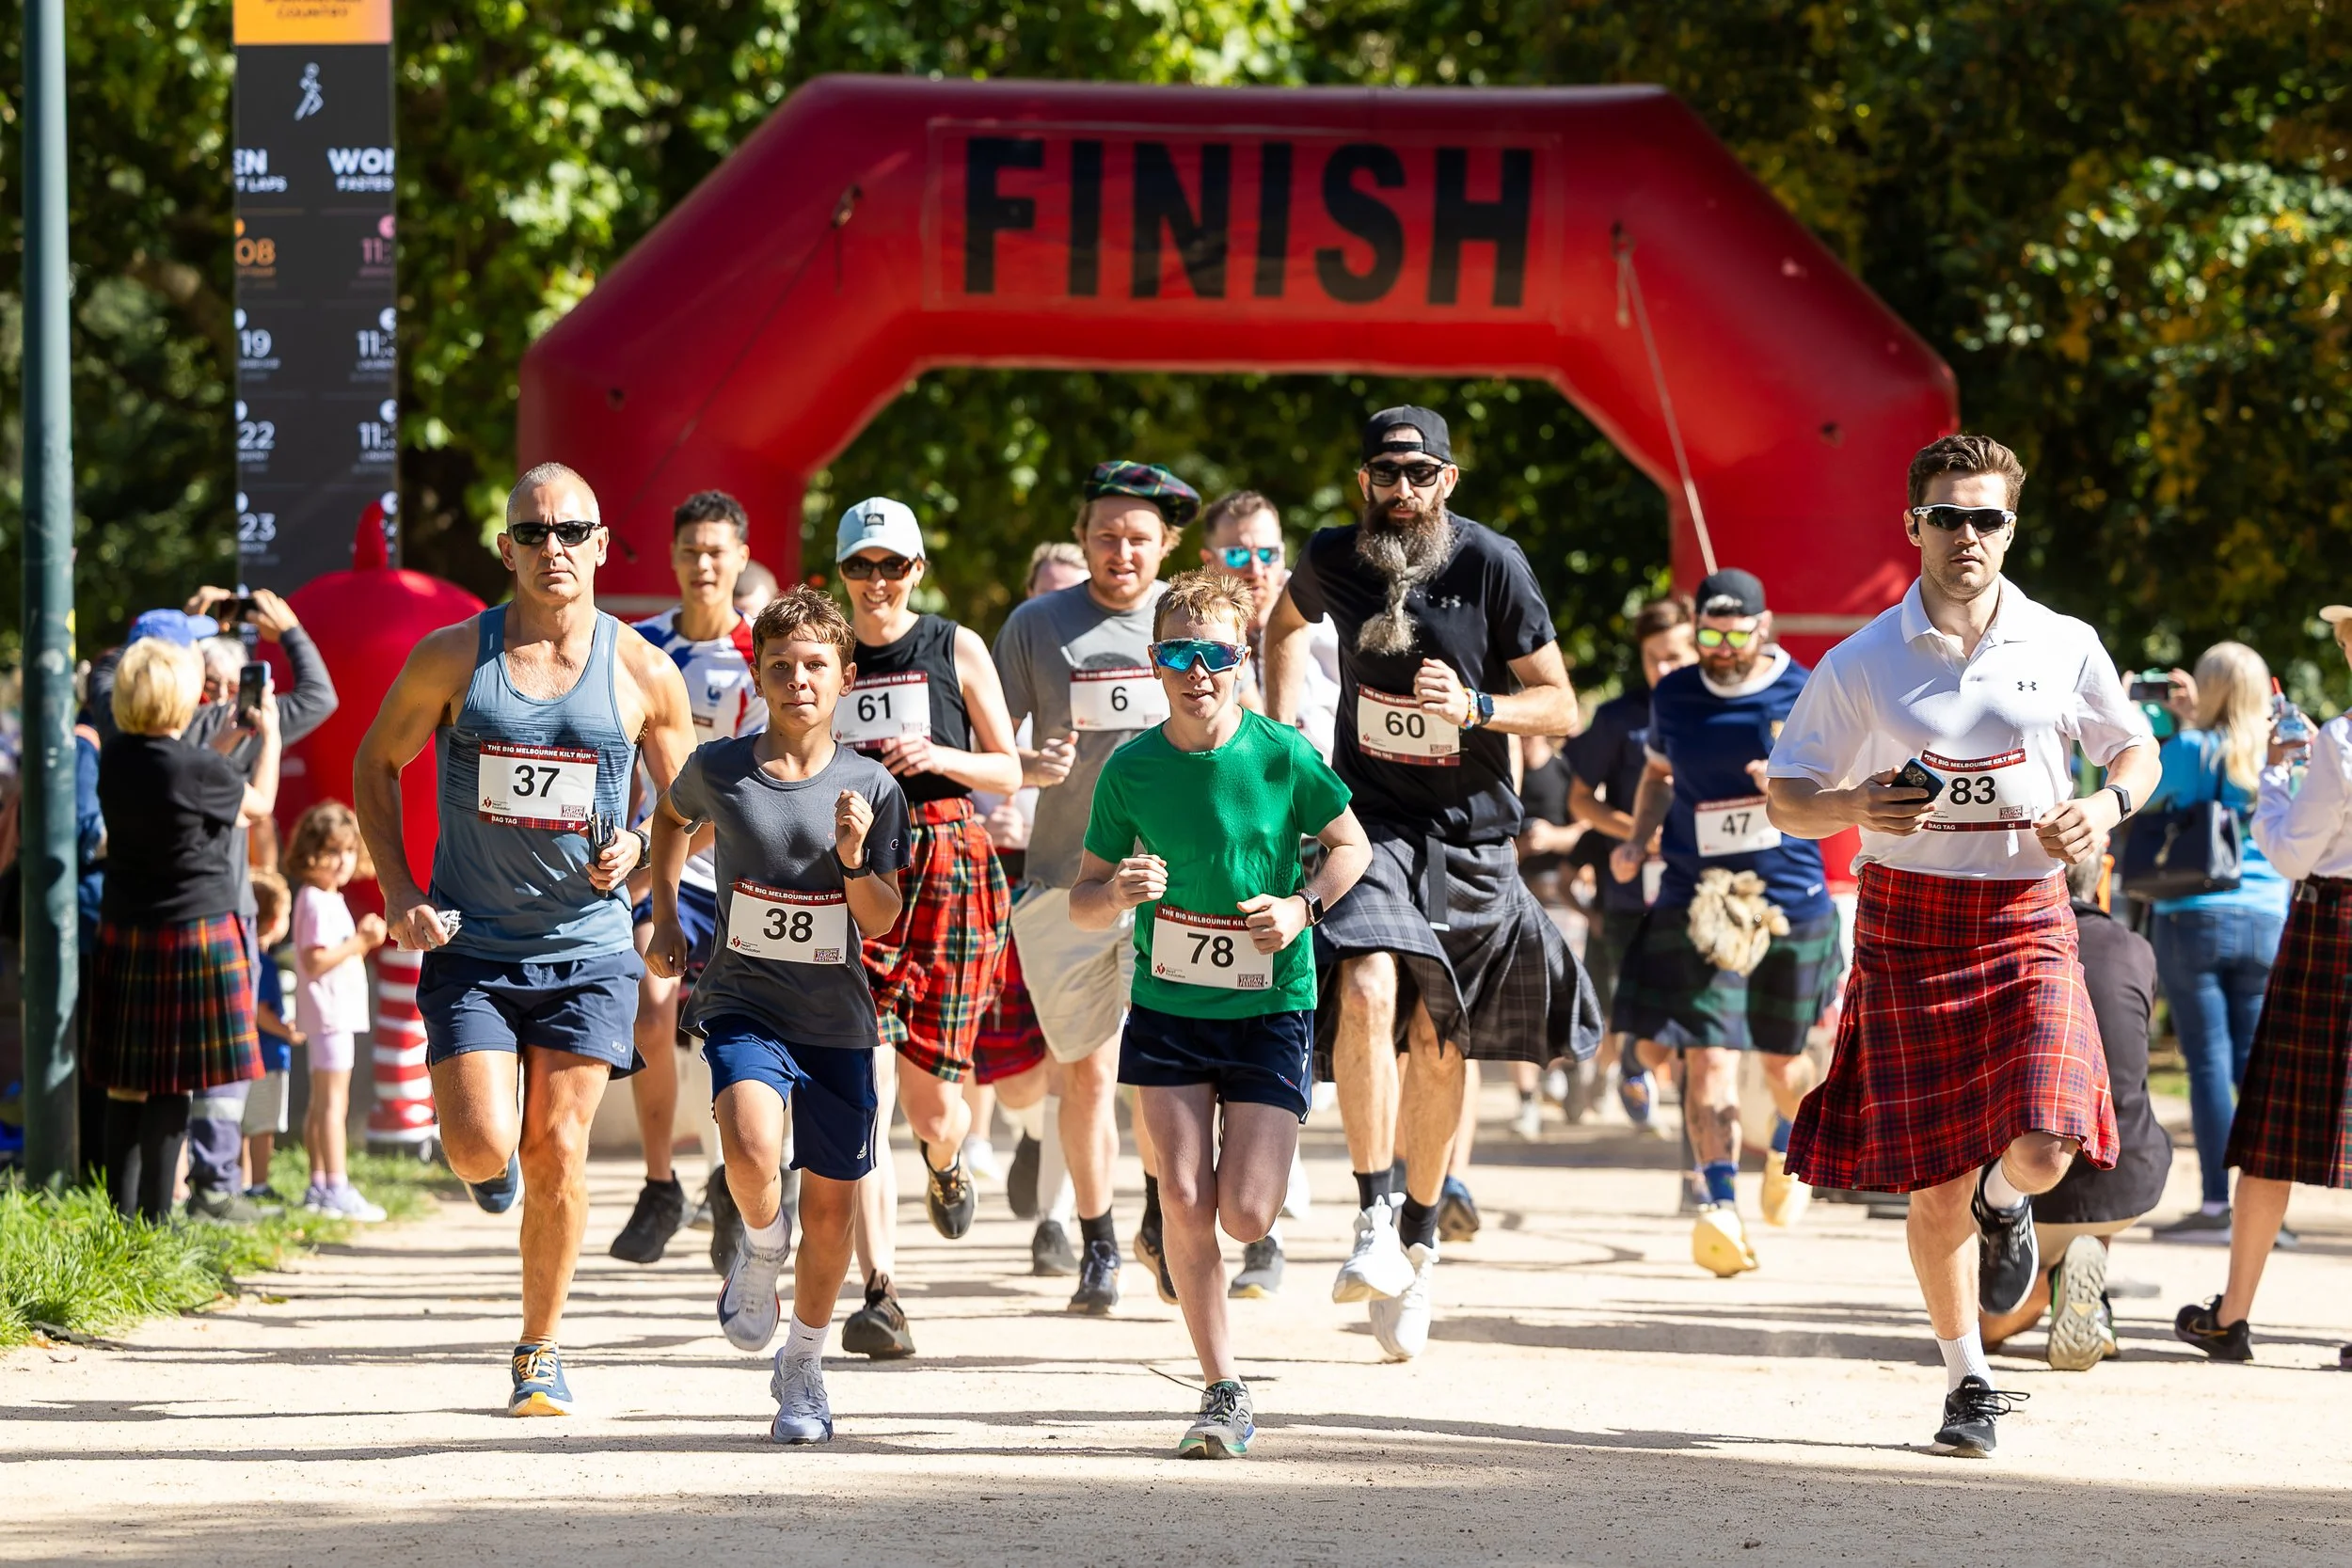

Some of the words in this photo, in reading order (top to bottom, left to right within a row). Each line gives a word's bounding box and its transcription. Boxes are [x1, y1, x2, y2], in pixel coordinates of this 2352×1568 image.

[963, 136, 1534, 309] FINISH
[857, 692, 891, 722] 61
[1111, 687, 1128, 711] 6
[1384, 696, 1418, 705] MELBOURN
[1385, 710, 1425, 738] 60
[516, 747, 557, 756] MELBOURNE
[1926, 755, 1937, 764] THE
[1938, 757, 1949, 767] BIG
[1950, 760, 1993, 768] MELBOURNE
[513, 764, 560, 798] 37
[1949, 776, 1996, 805] 83
[1721, 812, 1752, 836] 47
[740, 882, 754, 892] THE
[768, 890, 813, 901] MELBOURNE
[763, 908, 814, 943] 38
[1162, 908, 1174, 917] THE
[1175, 911, 1186, 920] BIG
[1187, 914, 1232, 927] MELBOURNE
[1187, 931, 1234, 968] 78
